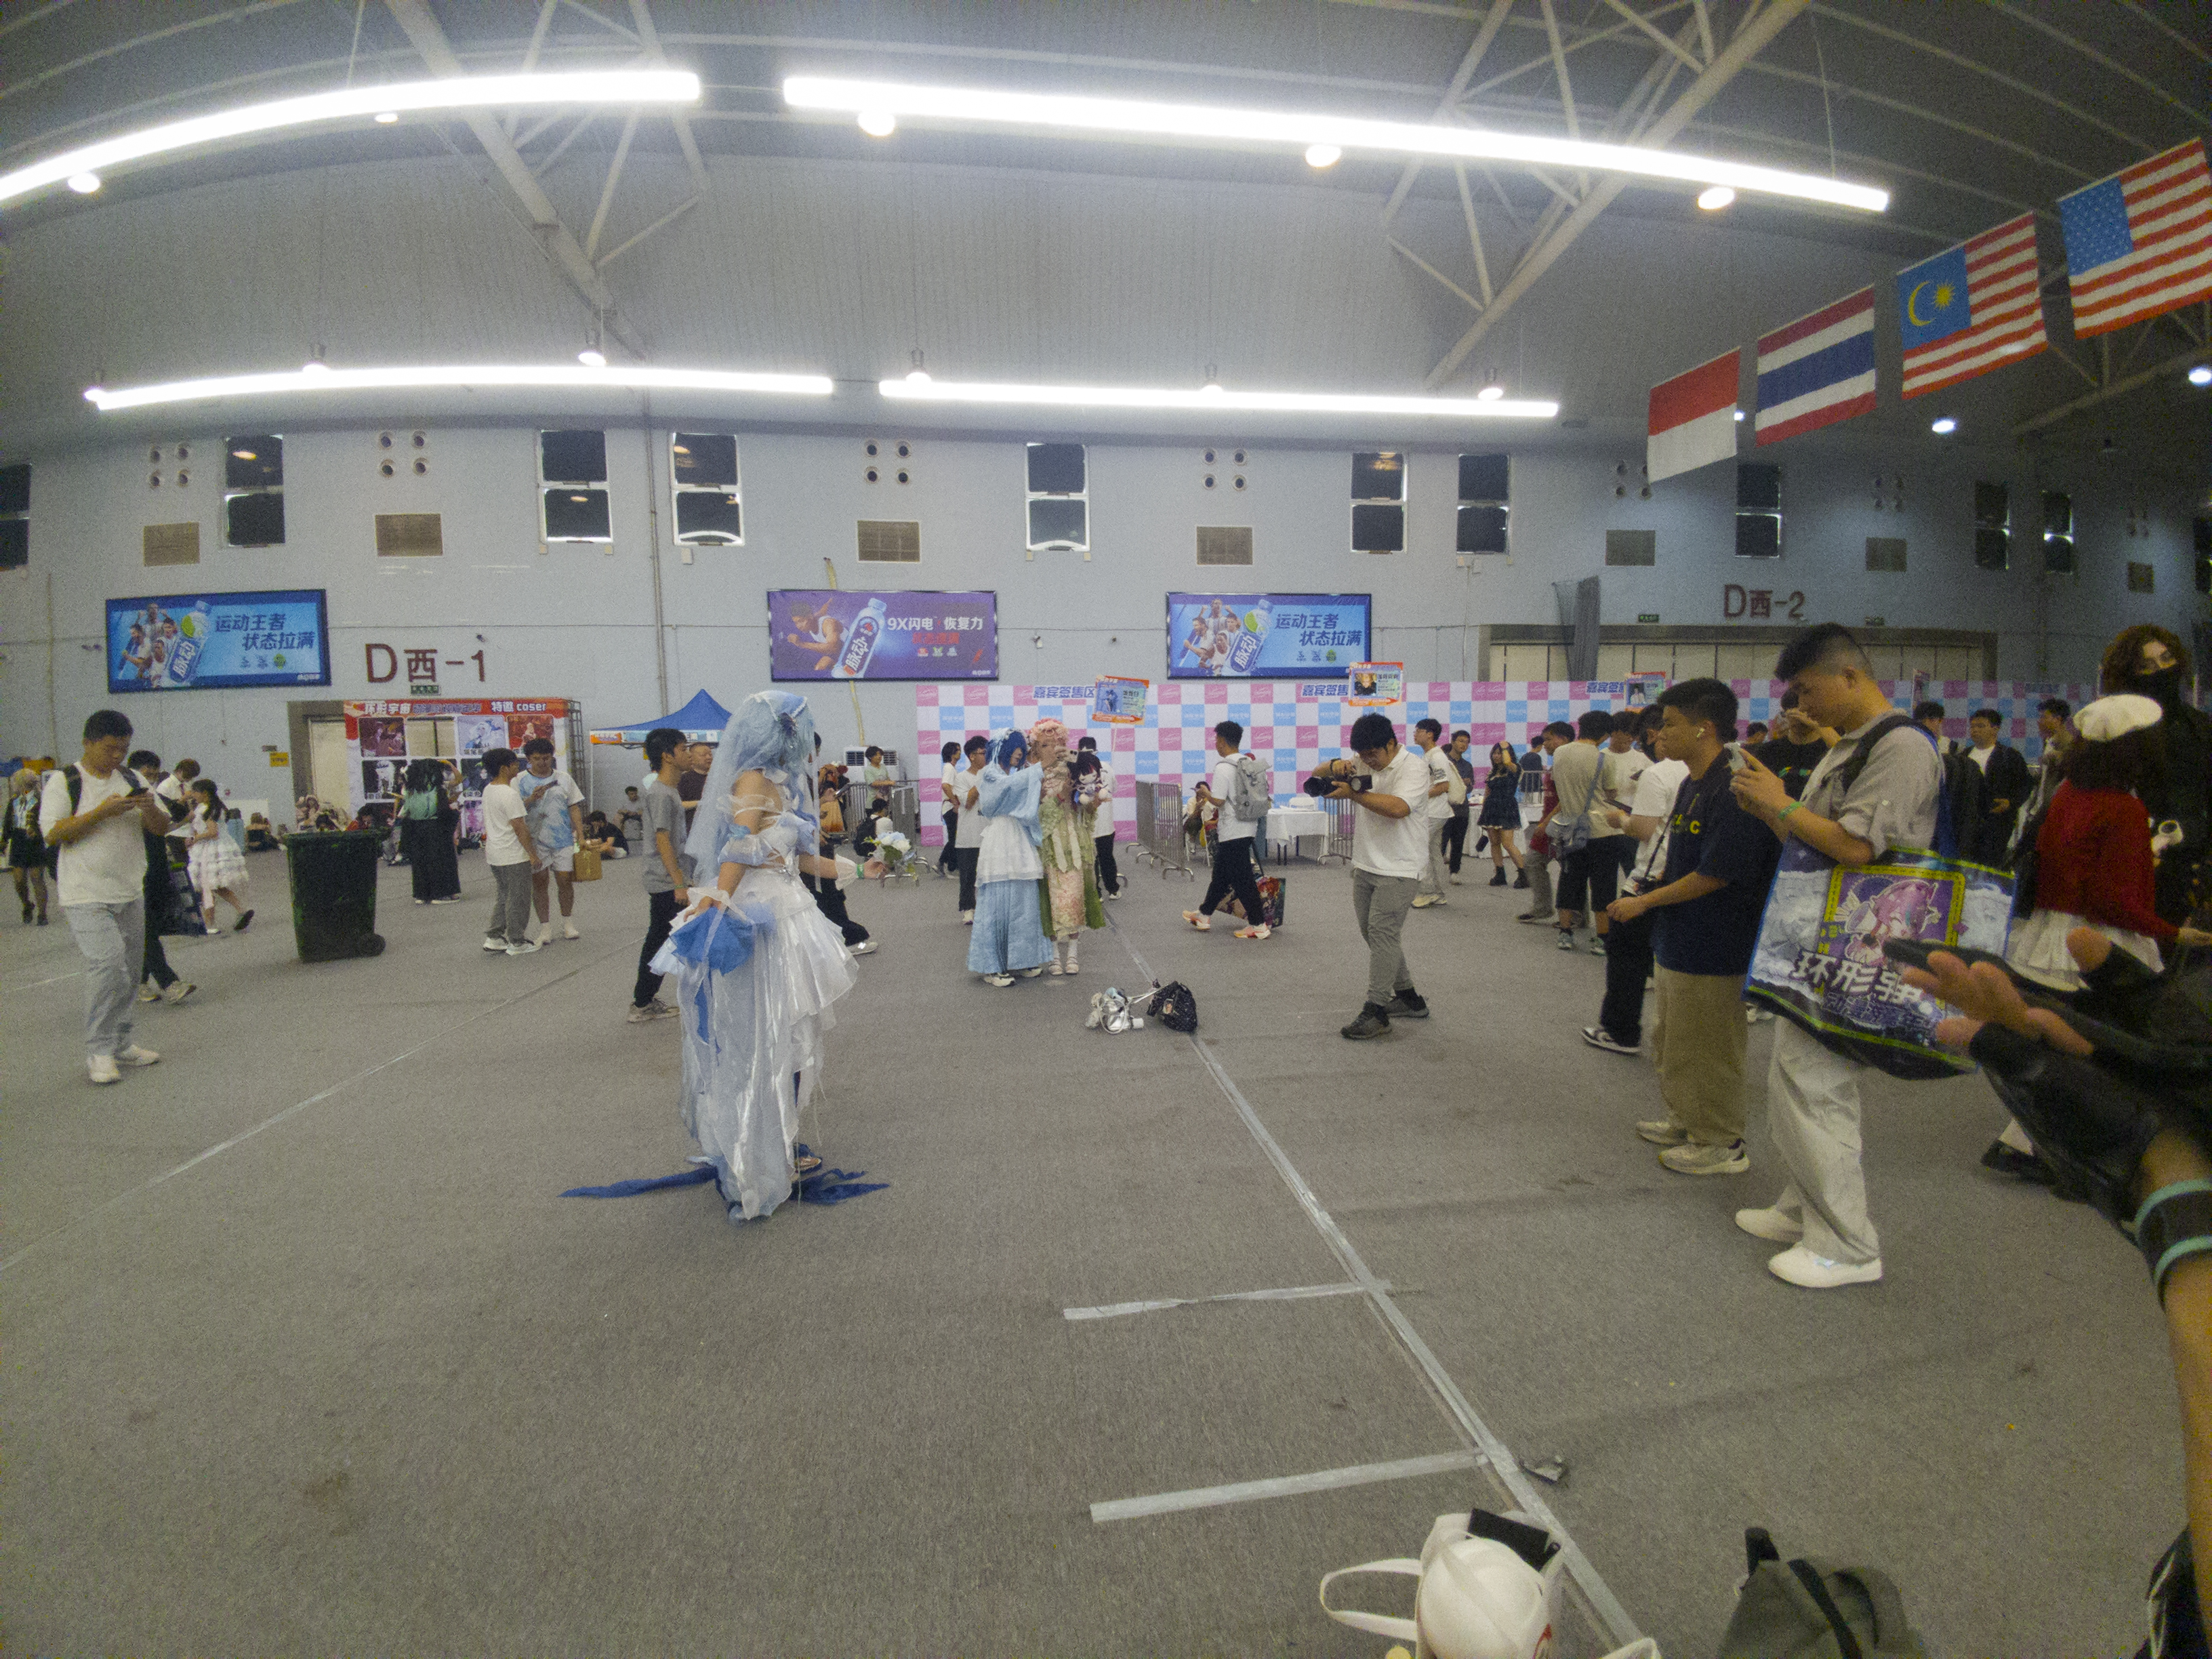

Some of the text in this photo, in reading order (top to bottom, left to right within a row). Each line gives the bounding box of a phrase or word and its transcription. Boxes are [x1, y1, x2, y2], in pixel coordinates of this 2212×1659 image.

[1723, 583, 1805, 619] D西-2
[215, 613, 287, 632] 运动王者
[943, 616, 983, 630] 恢复力
[1274, 613, 1339, 630] 运动王者
[241, 631, 316, 651] 状态拉满
[1298, 630, 1363, 647] 状态拉满
[1233, 634, 1256, 669] 脉动
[365, 643, 485, 683] D西-1
[1033, 686, 1095, 699] 嘉宾签售区
